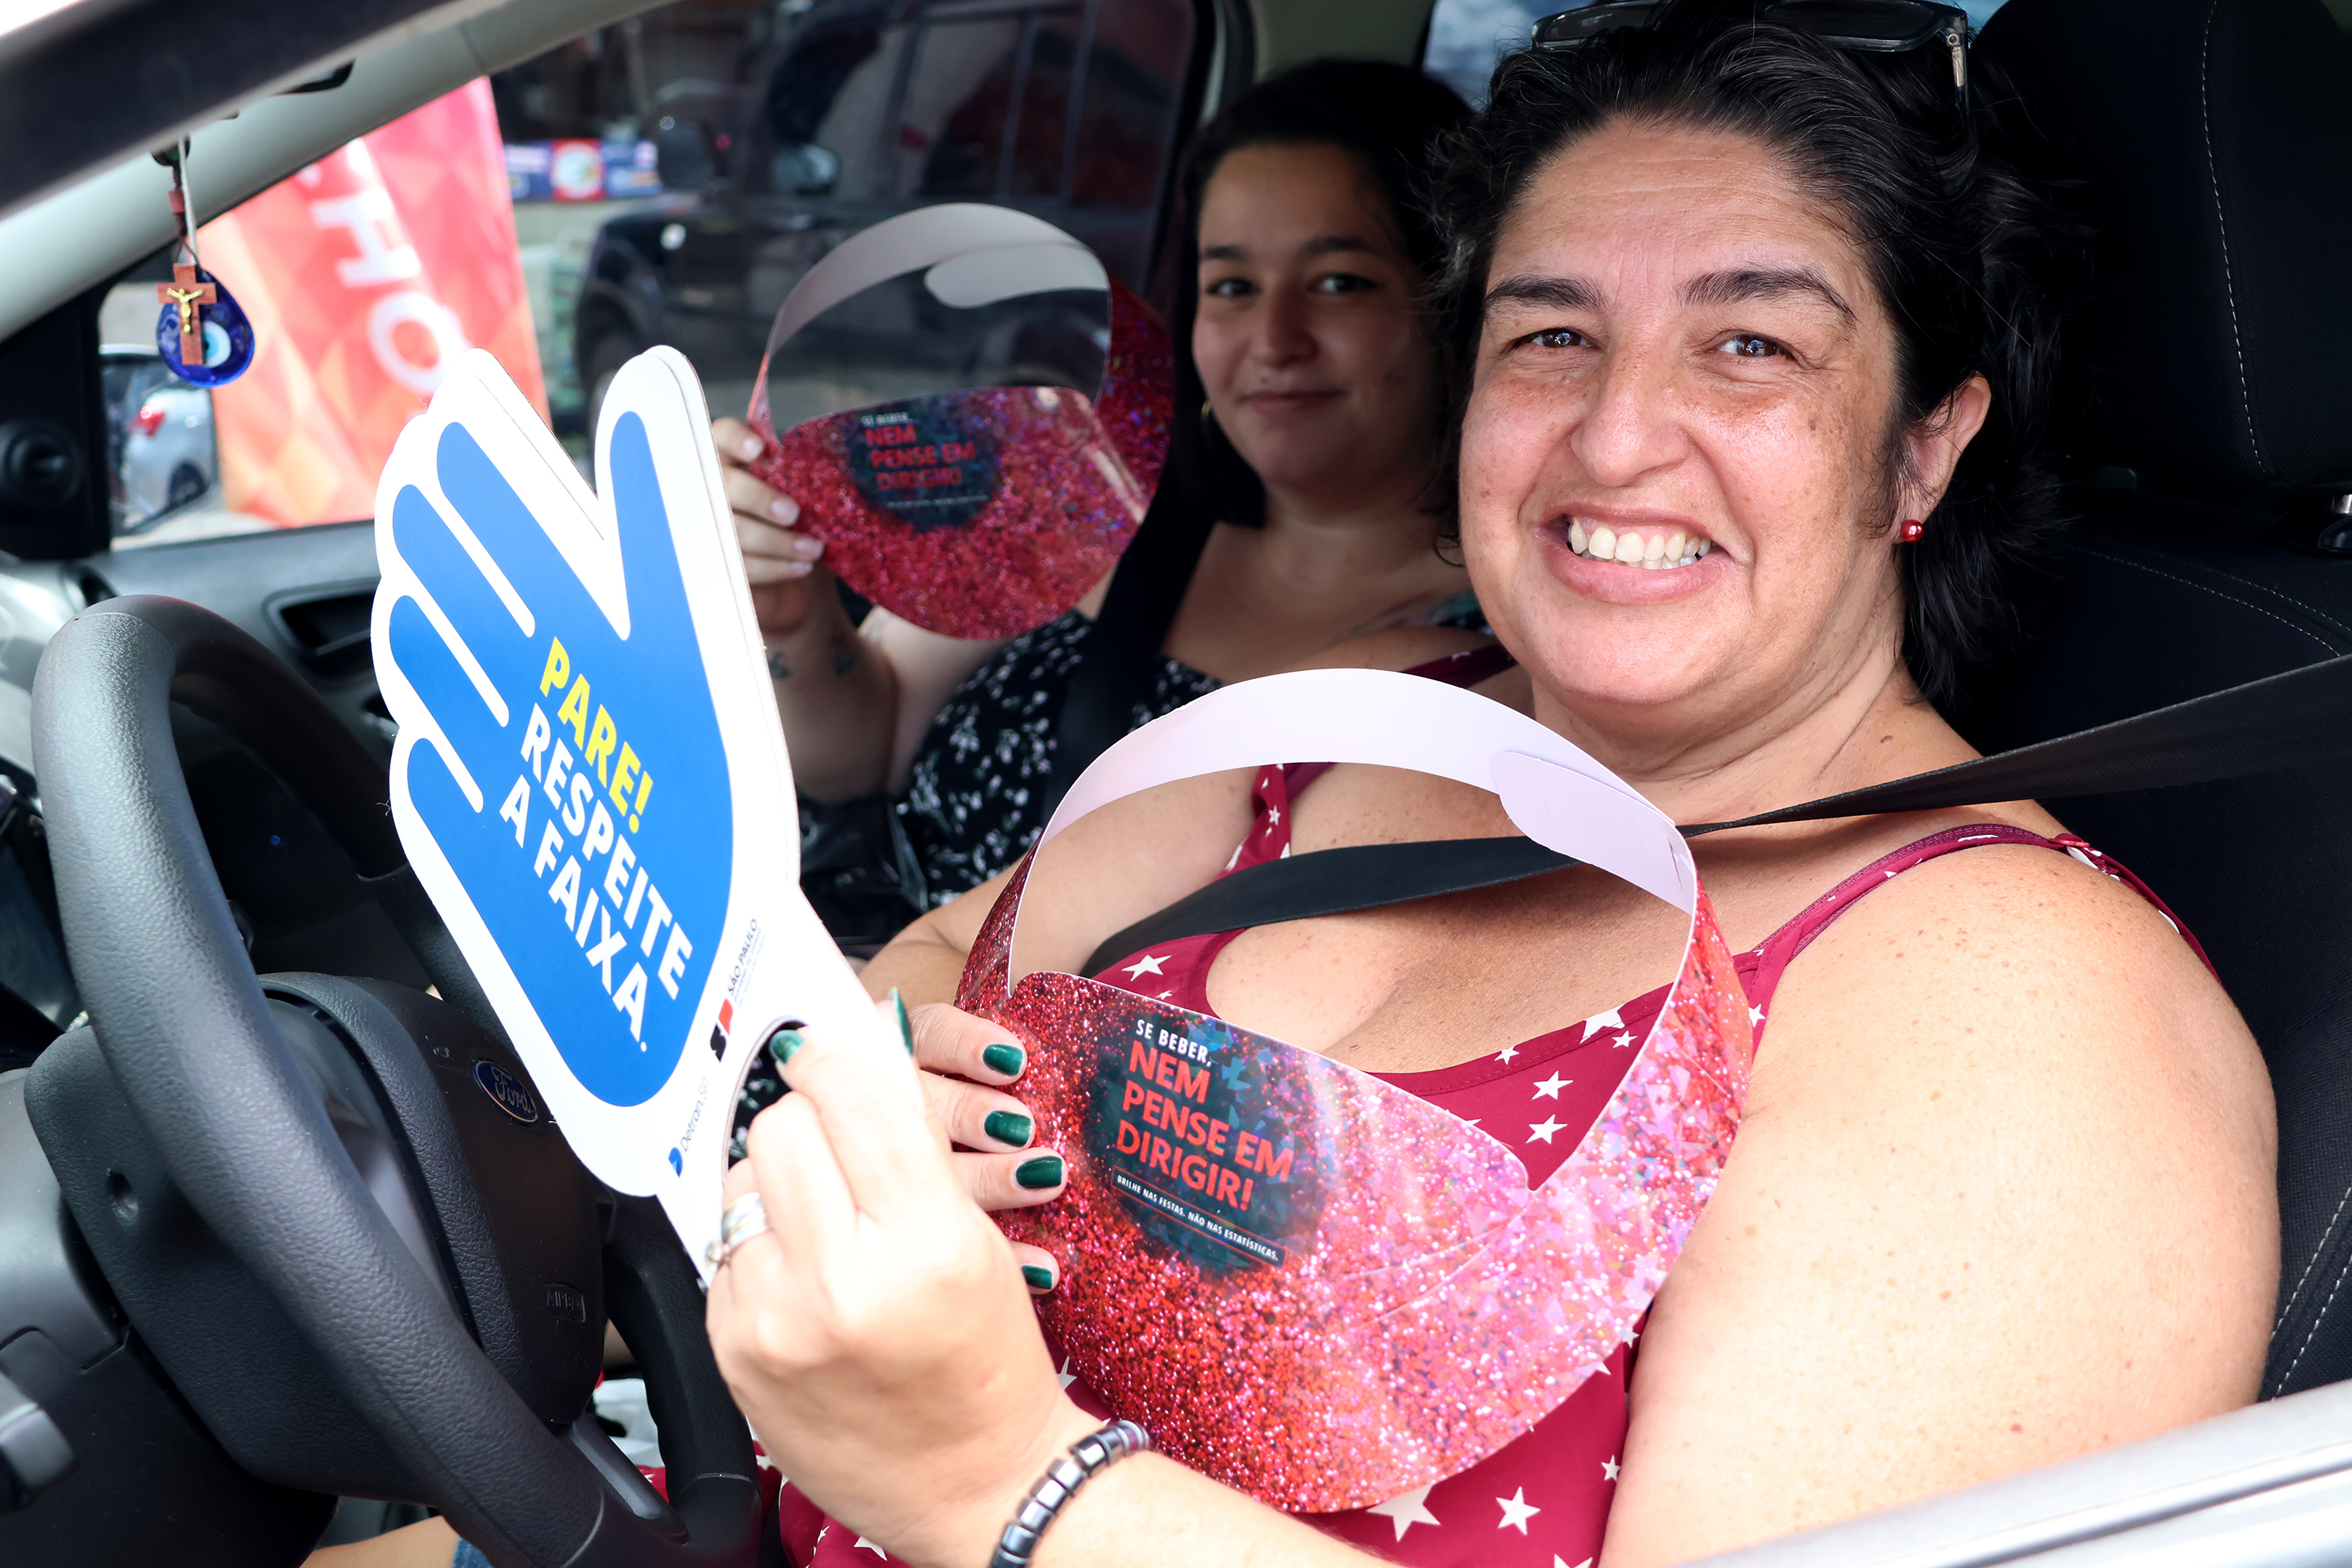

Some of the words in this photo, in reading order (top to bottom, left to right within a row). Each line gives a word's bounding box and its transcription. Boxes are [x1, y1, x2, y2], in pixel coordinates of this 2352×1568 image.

[865, 424, 916, 448] NEM
[870, 445, 938, 468] PENSE
[942, 441, 976, 464] EM
[539, 636, 654, 834] PARE!
[521, 702, 693, 1000] RESPEITE
[499, 774, 531, 848] A
[534, 818, 648, 1053] FAIXA.
[728, 965, 741, 993] SÃO
[738, 918, 757, 966] PAULO
[1129, 1040, 1211, 1104] NEM
[1136, 1018, 1154, 1040] SE
[1158, 1029, 1212, 1068] BEBER,
[491, 1066, 532, 1113] Ford
[1116, 1120, 1254, 1211] DIRIGIR!
[1122, 1080, 1230, 1156] PENSE
[1234, 1131, 1294, 1182] EM
[1117, 1174, 1142, 1194] BRILHE
[1143, 1189, 1158, 1203] NAS
[1159, 1197, 1185, 1217] FESTAS.
[1188, 1211, 1205, 1226] NÃO
[1207, 1221, 1223, 1235] NAS
[1224, 1229, 1279, 1261] ESTATÍSTICAS.
